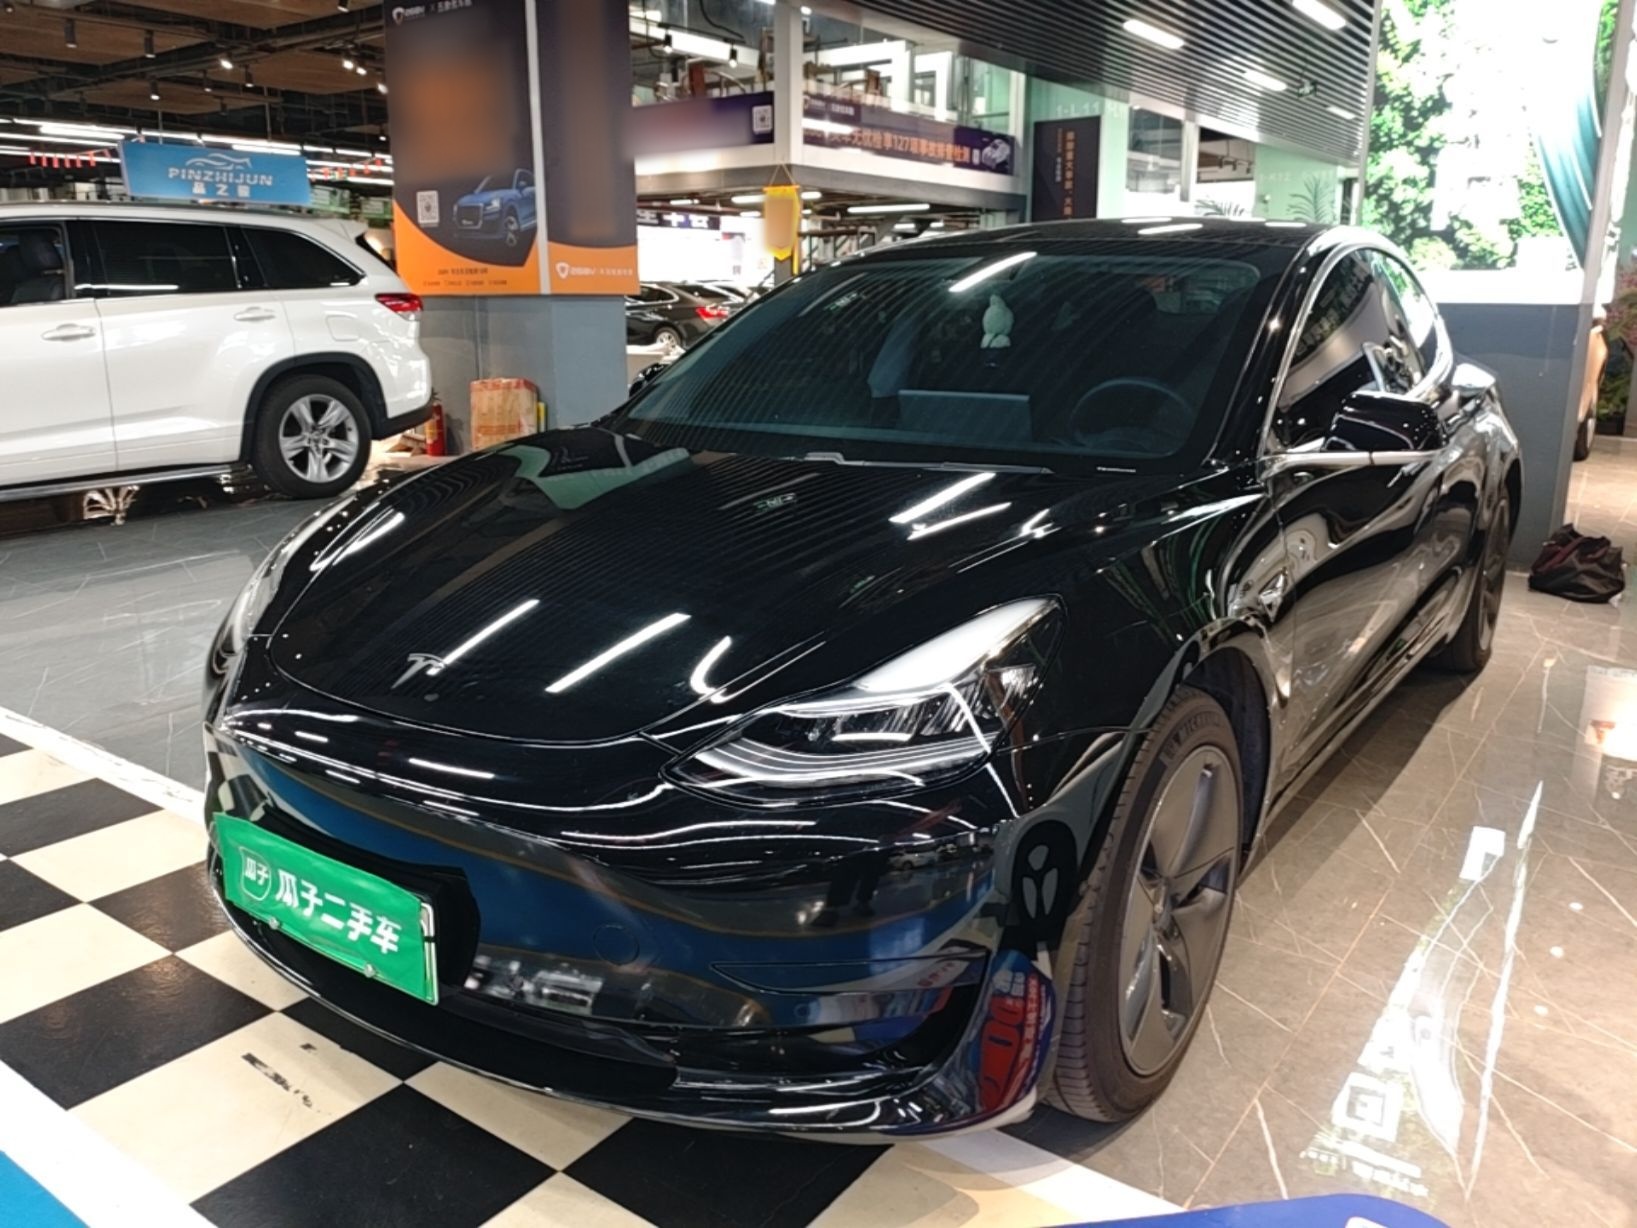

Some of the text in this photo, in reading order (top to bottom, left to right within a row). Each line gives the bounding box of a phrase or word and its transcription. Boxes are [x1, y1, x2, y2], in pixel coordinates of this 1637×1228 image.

[168, 167, 273, 186] PINZHIJUN
[244, 856, 270, 886] 瓜子
[275, 868, 402, 955] 瓜子二手车
